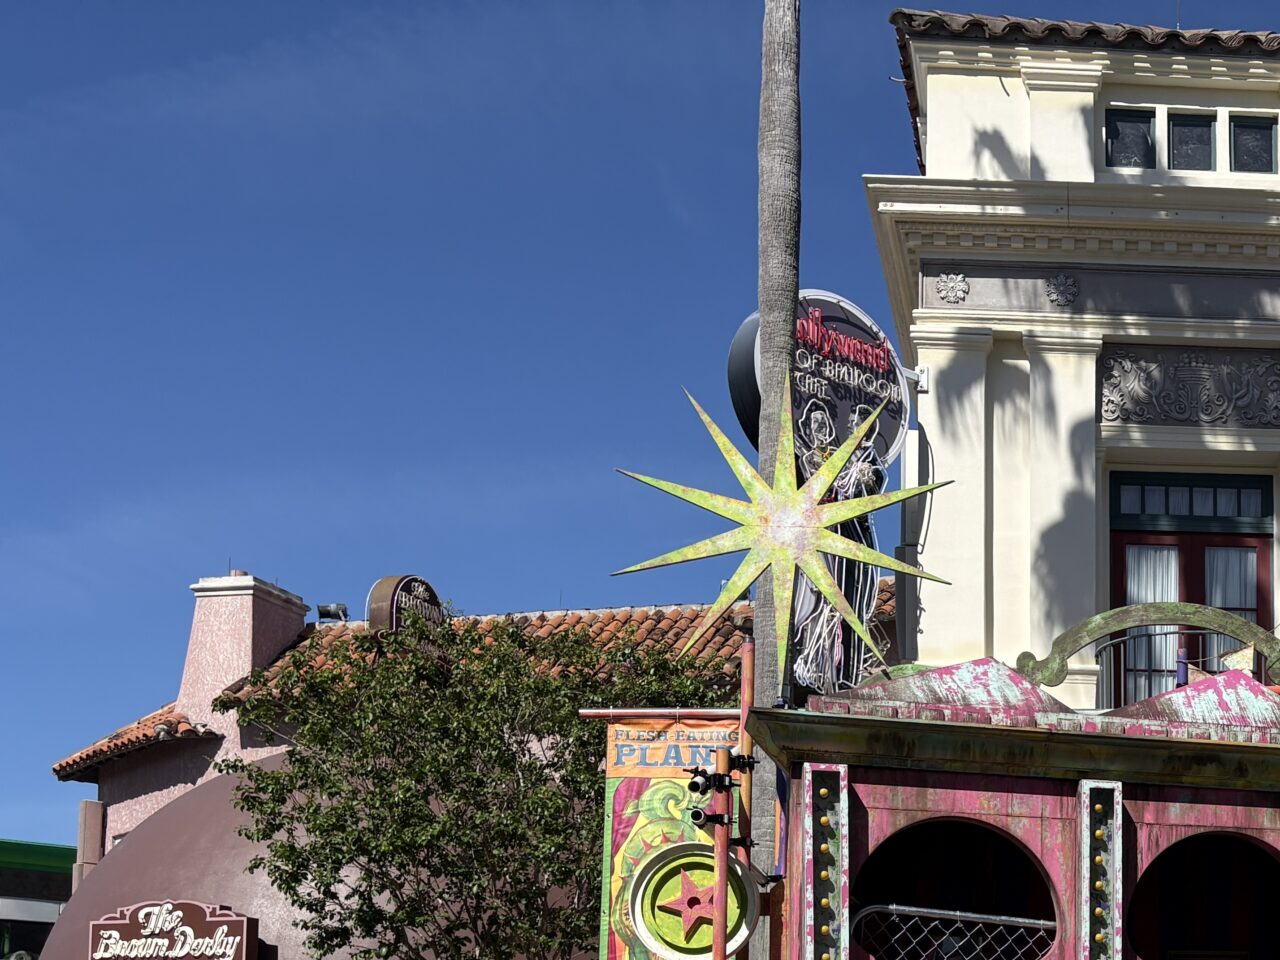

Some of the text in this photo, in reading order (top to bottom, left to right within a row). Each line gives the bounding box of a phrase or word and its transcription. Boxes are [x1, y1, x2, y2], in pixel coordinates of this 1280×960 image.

[796, 307, 889, 373] ollywood
[614, 729, 739, 742] FLESH-EATING
[613, 743, 735, 767] PLAN
[138, 903, 183, 935] The
[93, 930, 169, 959] Brown
